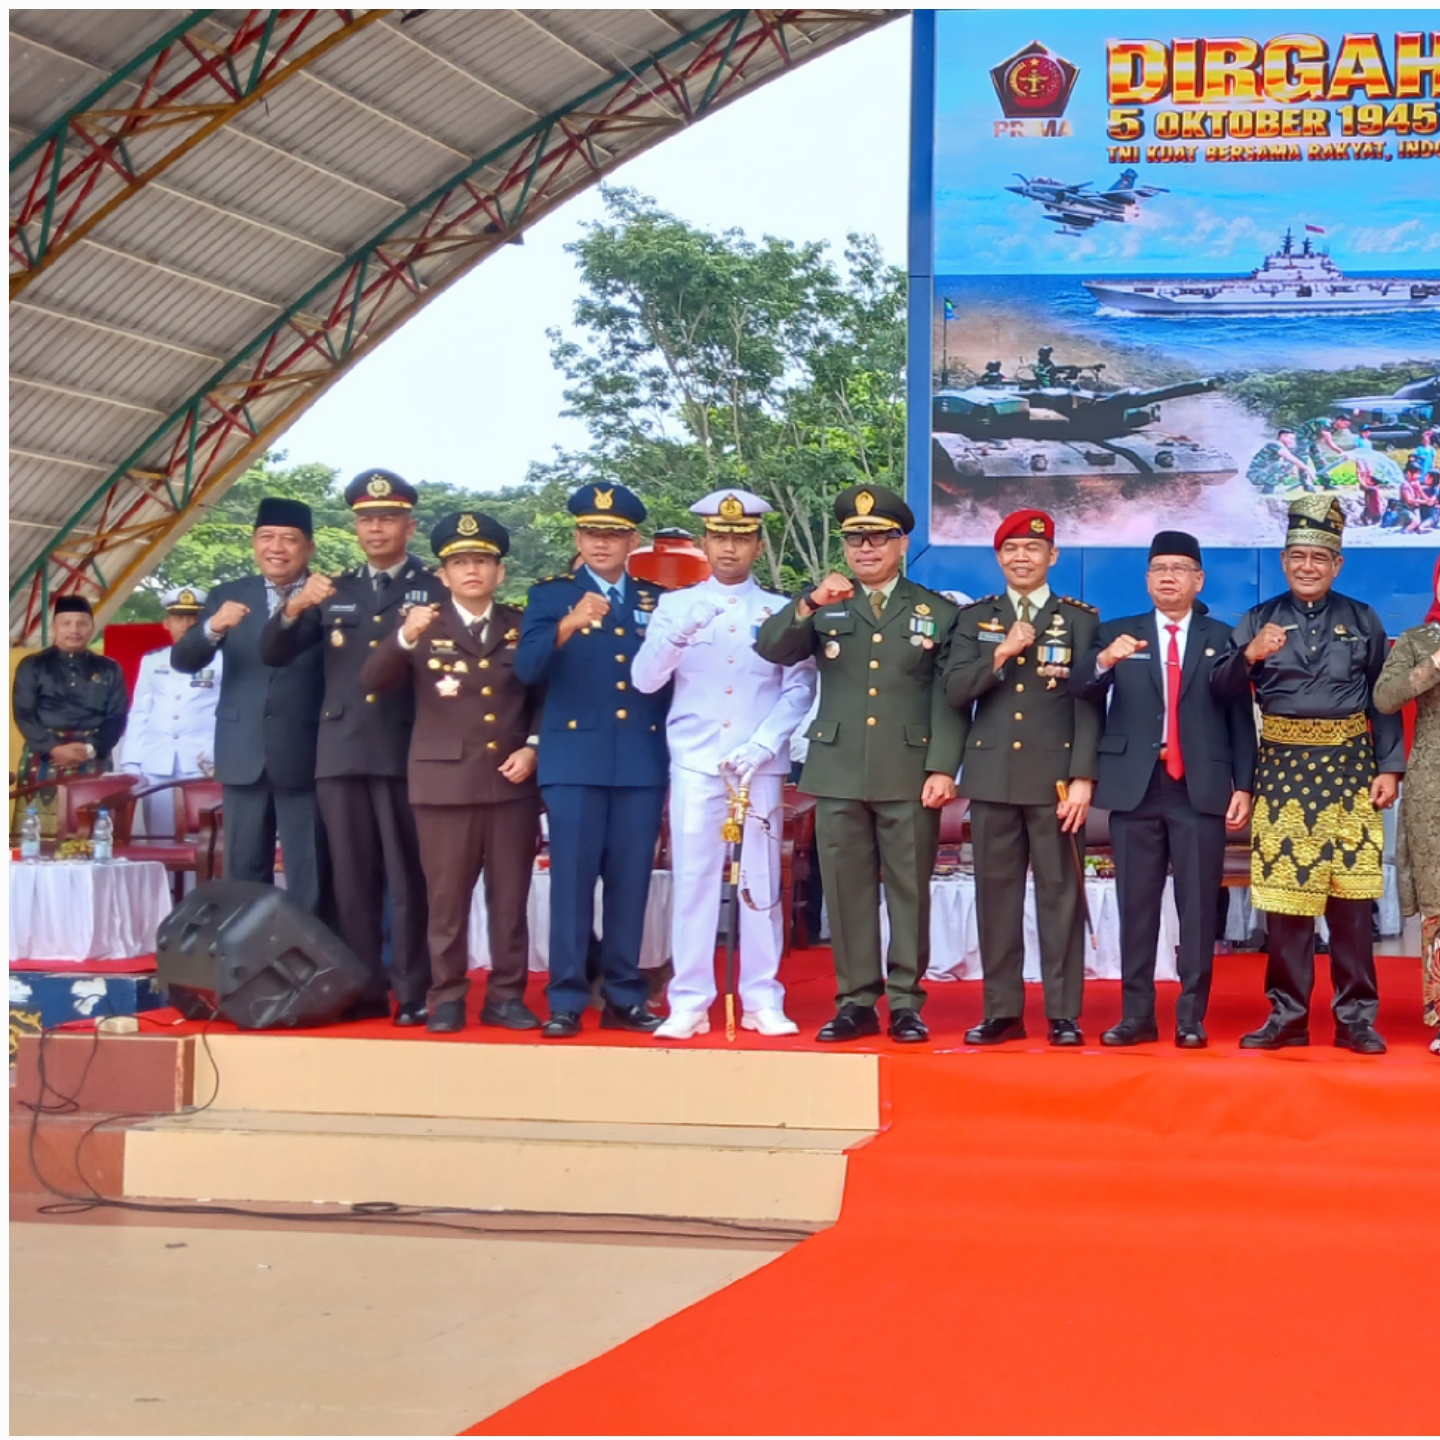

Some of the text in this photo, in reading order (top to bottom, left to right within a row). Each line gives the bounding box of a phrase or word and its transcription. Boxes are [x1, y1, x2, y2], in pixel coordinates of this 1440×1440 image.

[993, 120, 1074, 138] PRIMA
[1107, 108, 1145, 141] 5
[1154, 108, 1329, 140] OKTOBER
[1107, 145, 1140, 163] TNI
[1146, 144, 1200, 163] KUAT
[1205, 143, 1302, 162] BERSAMA
[1307, 142, 1391, 161] RAKYAT,
